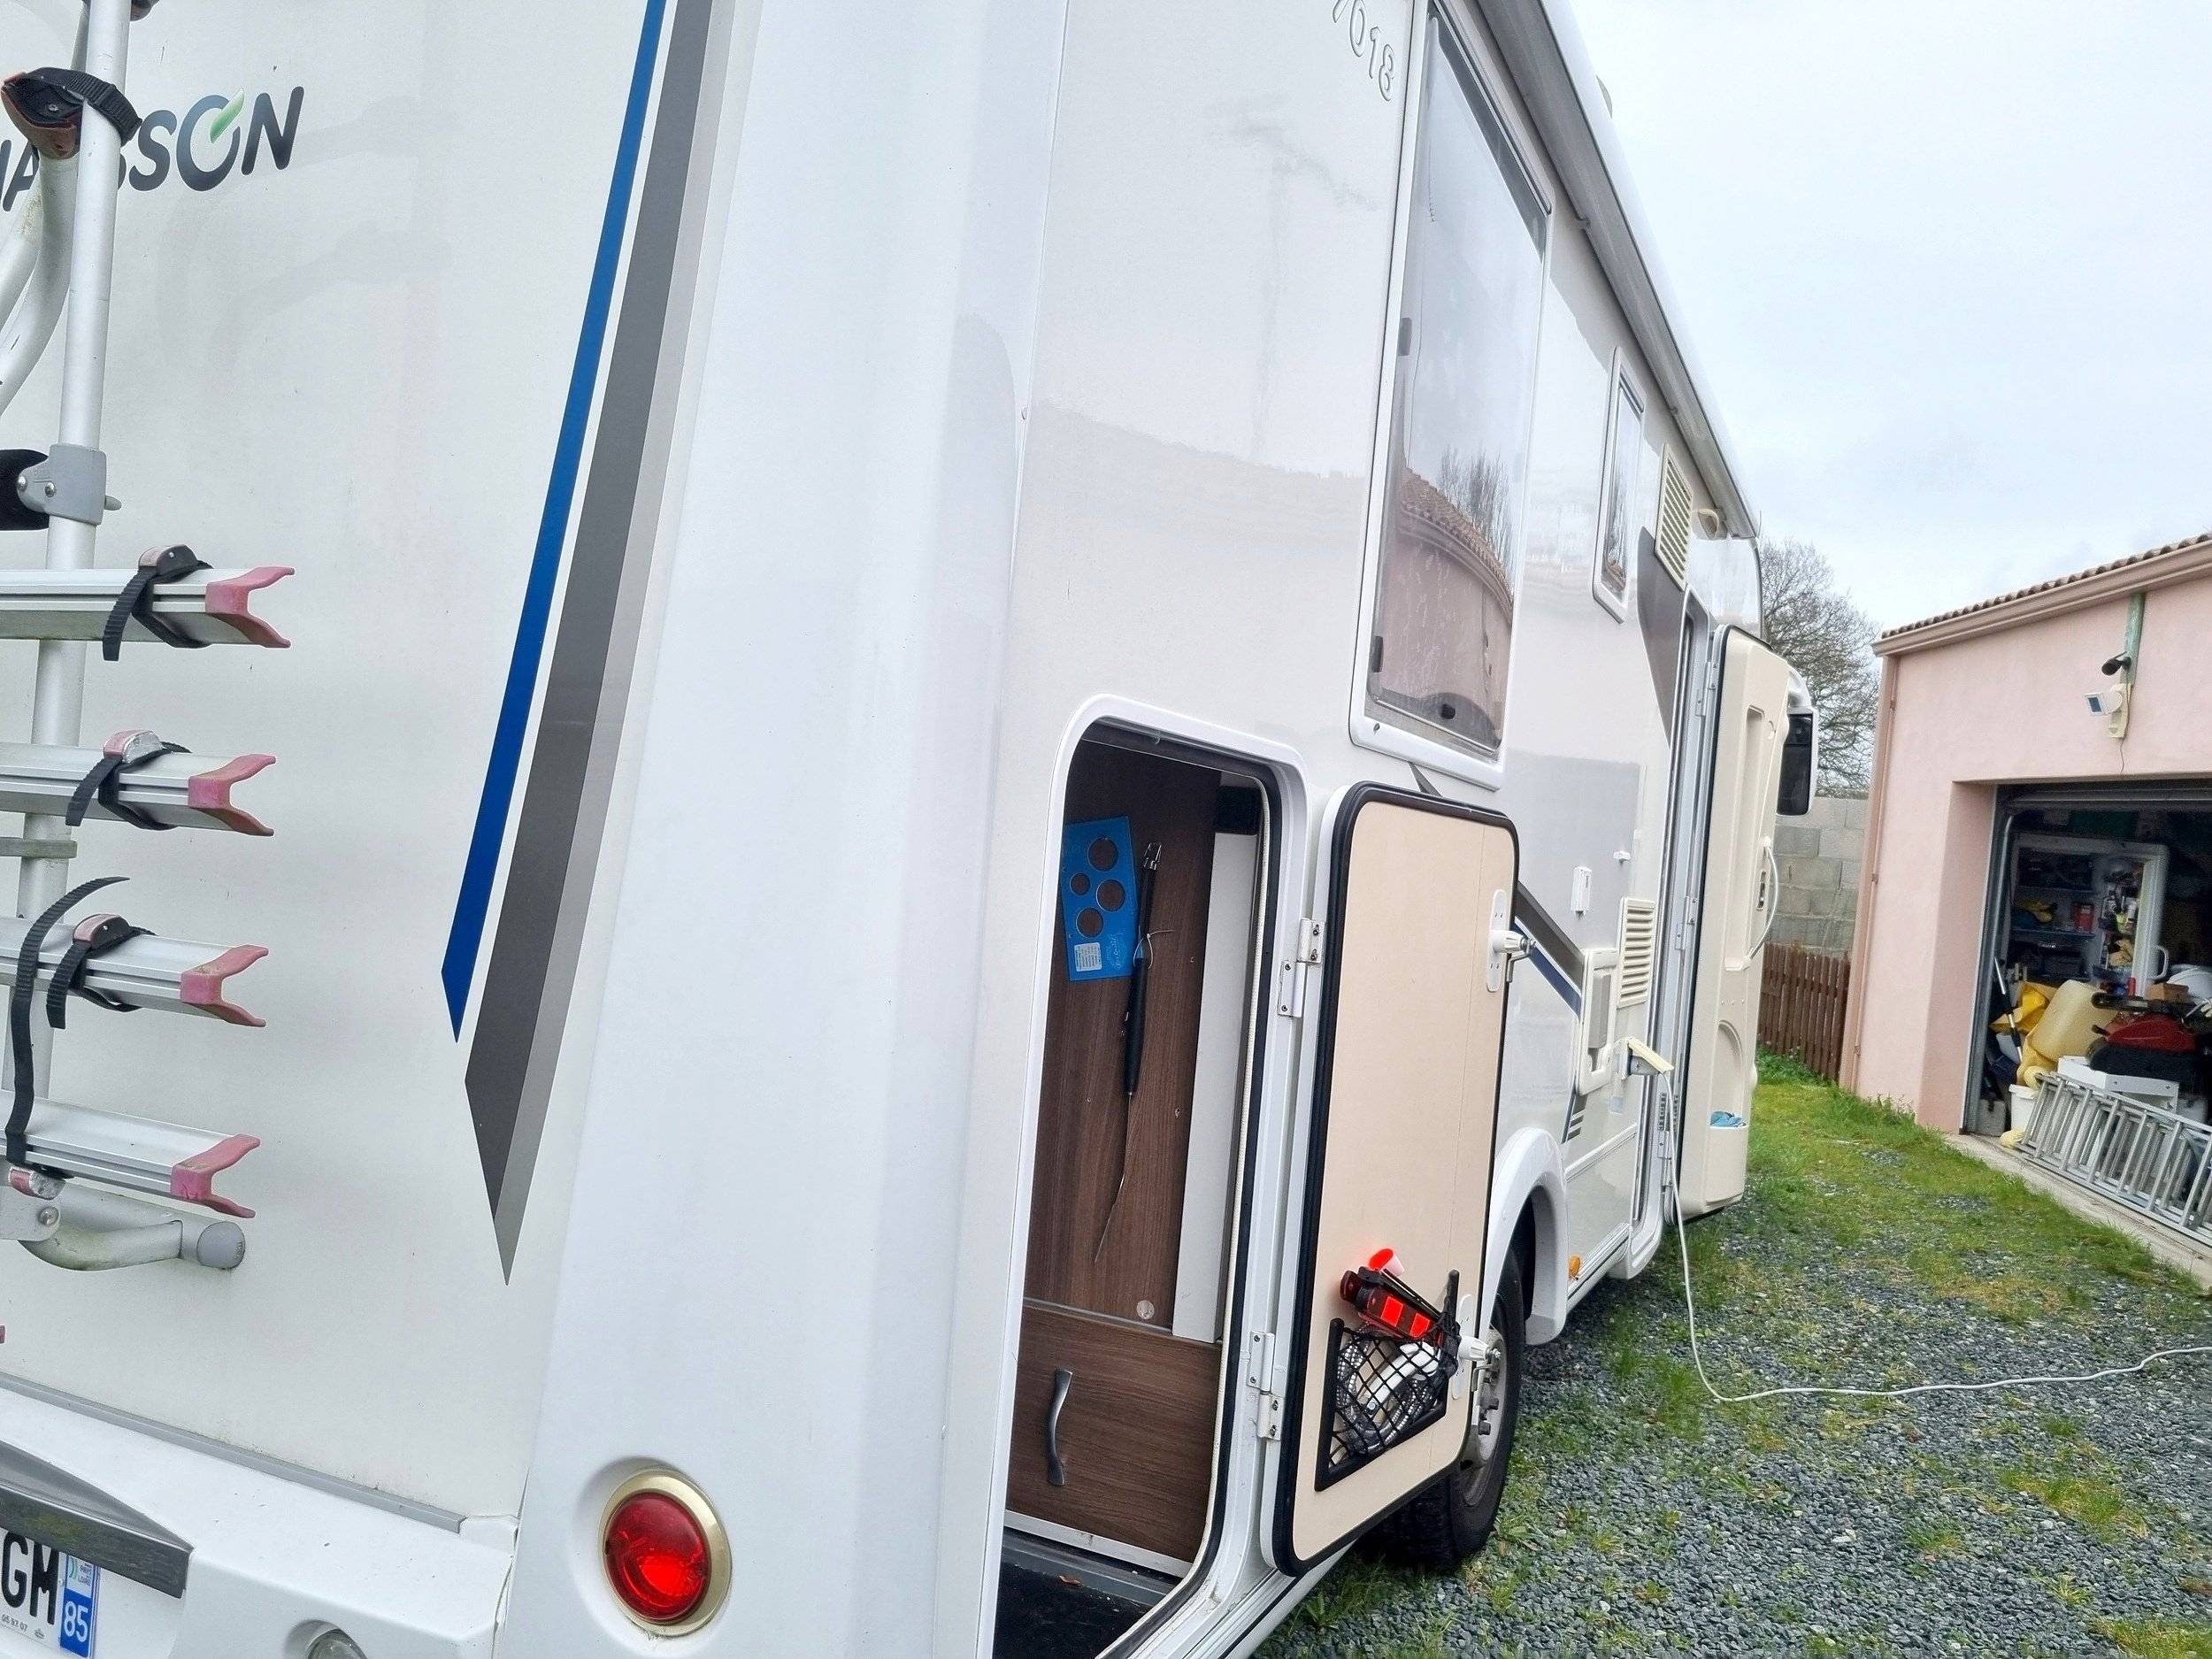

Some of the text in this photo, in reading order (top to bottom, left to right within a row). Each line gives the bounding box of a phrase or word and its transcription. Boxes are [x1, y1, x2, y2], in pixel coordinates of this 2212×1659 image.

[0, 86, 304, 212] ASON
[2, 1531, 59, 1625] GM
[64, 1601, 88, 1642] 85
